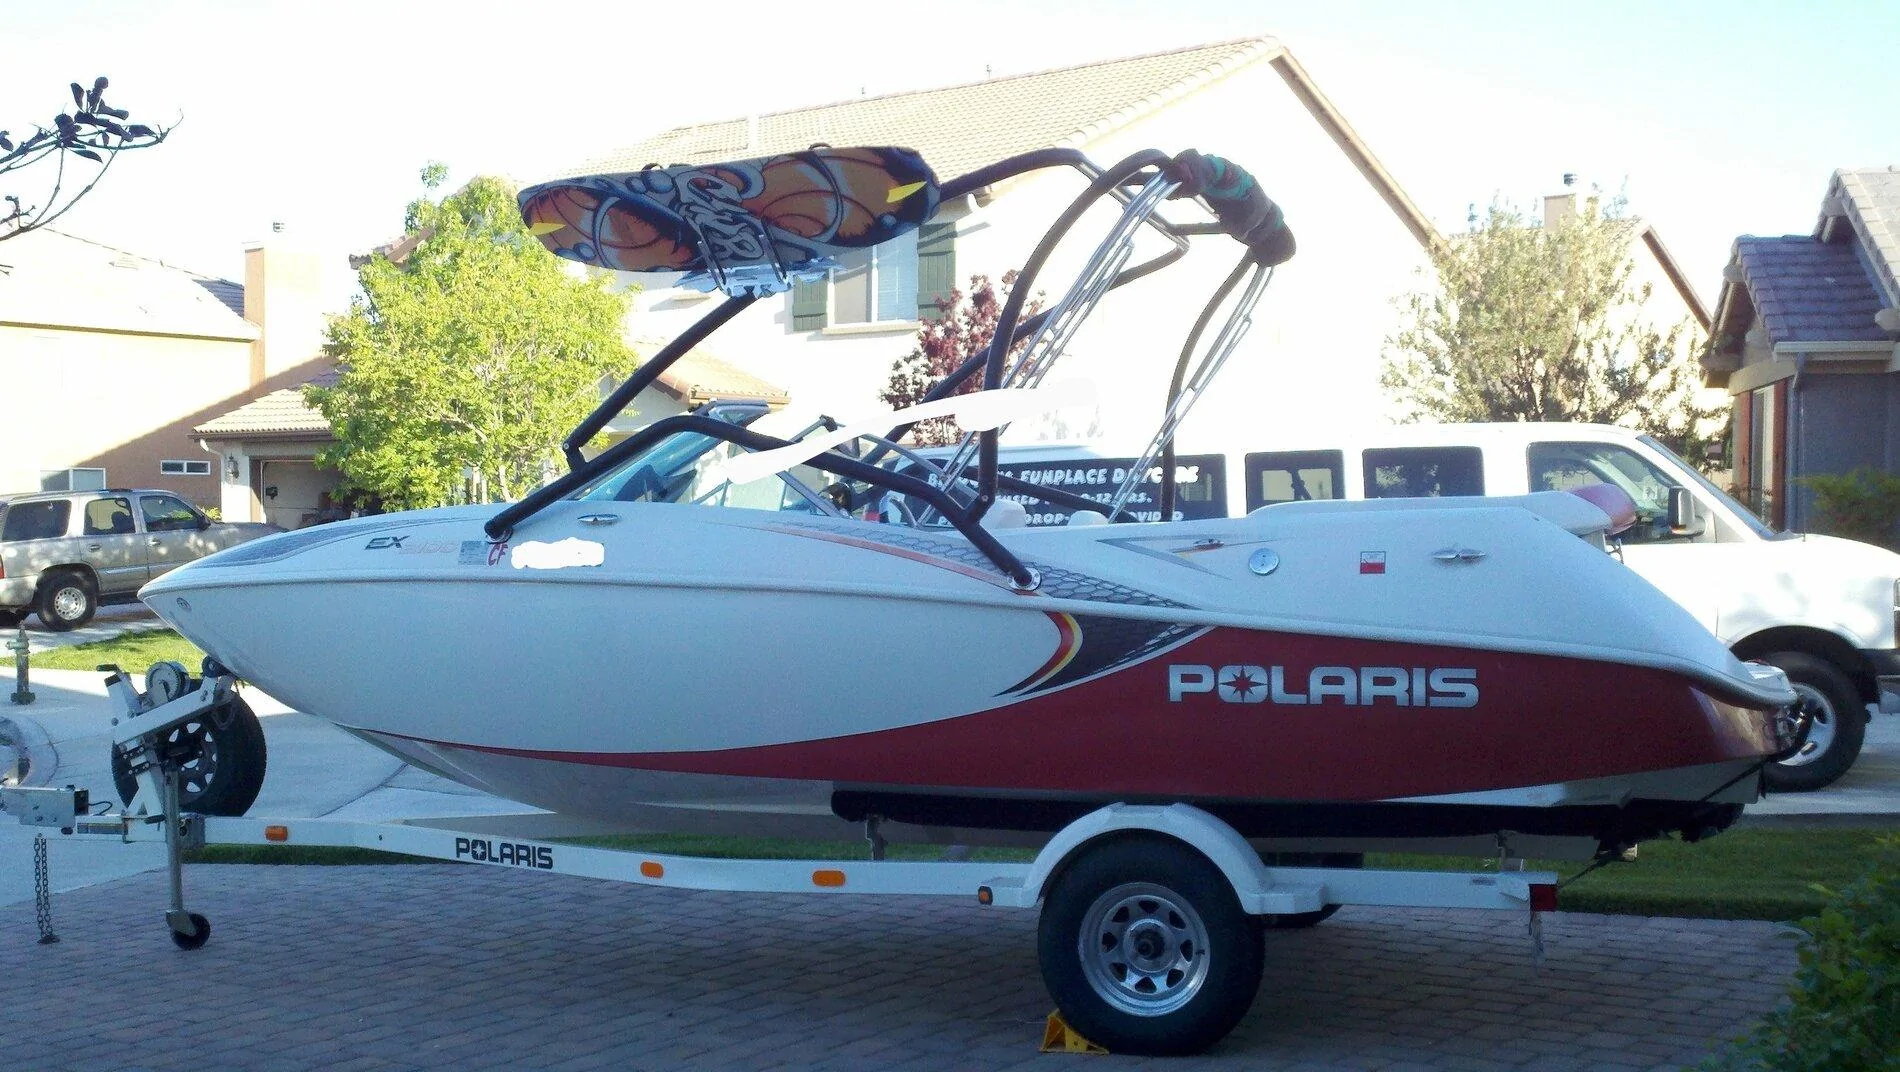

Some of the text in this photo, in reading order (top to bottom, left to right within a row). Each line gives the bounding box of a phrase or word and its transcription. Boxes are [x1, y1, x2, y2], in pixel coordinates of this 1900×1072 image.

[1021, 468, 1107, 486] FUNPLACE
[487, 543, 508, 567] CF
[1169, 664, 1479, 708] POLARIS
[456, 838, 553, 870] POLARIS
